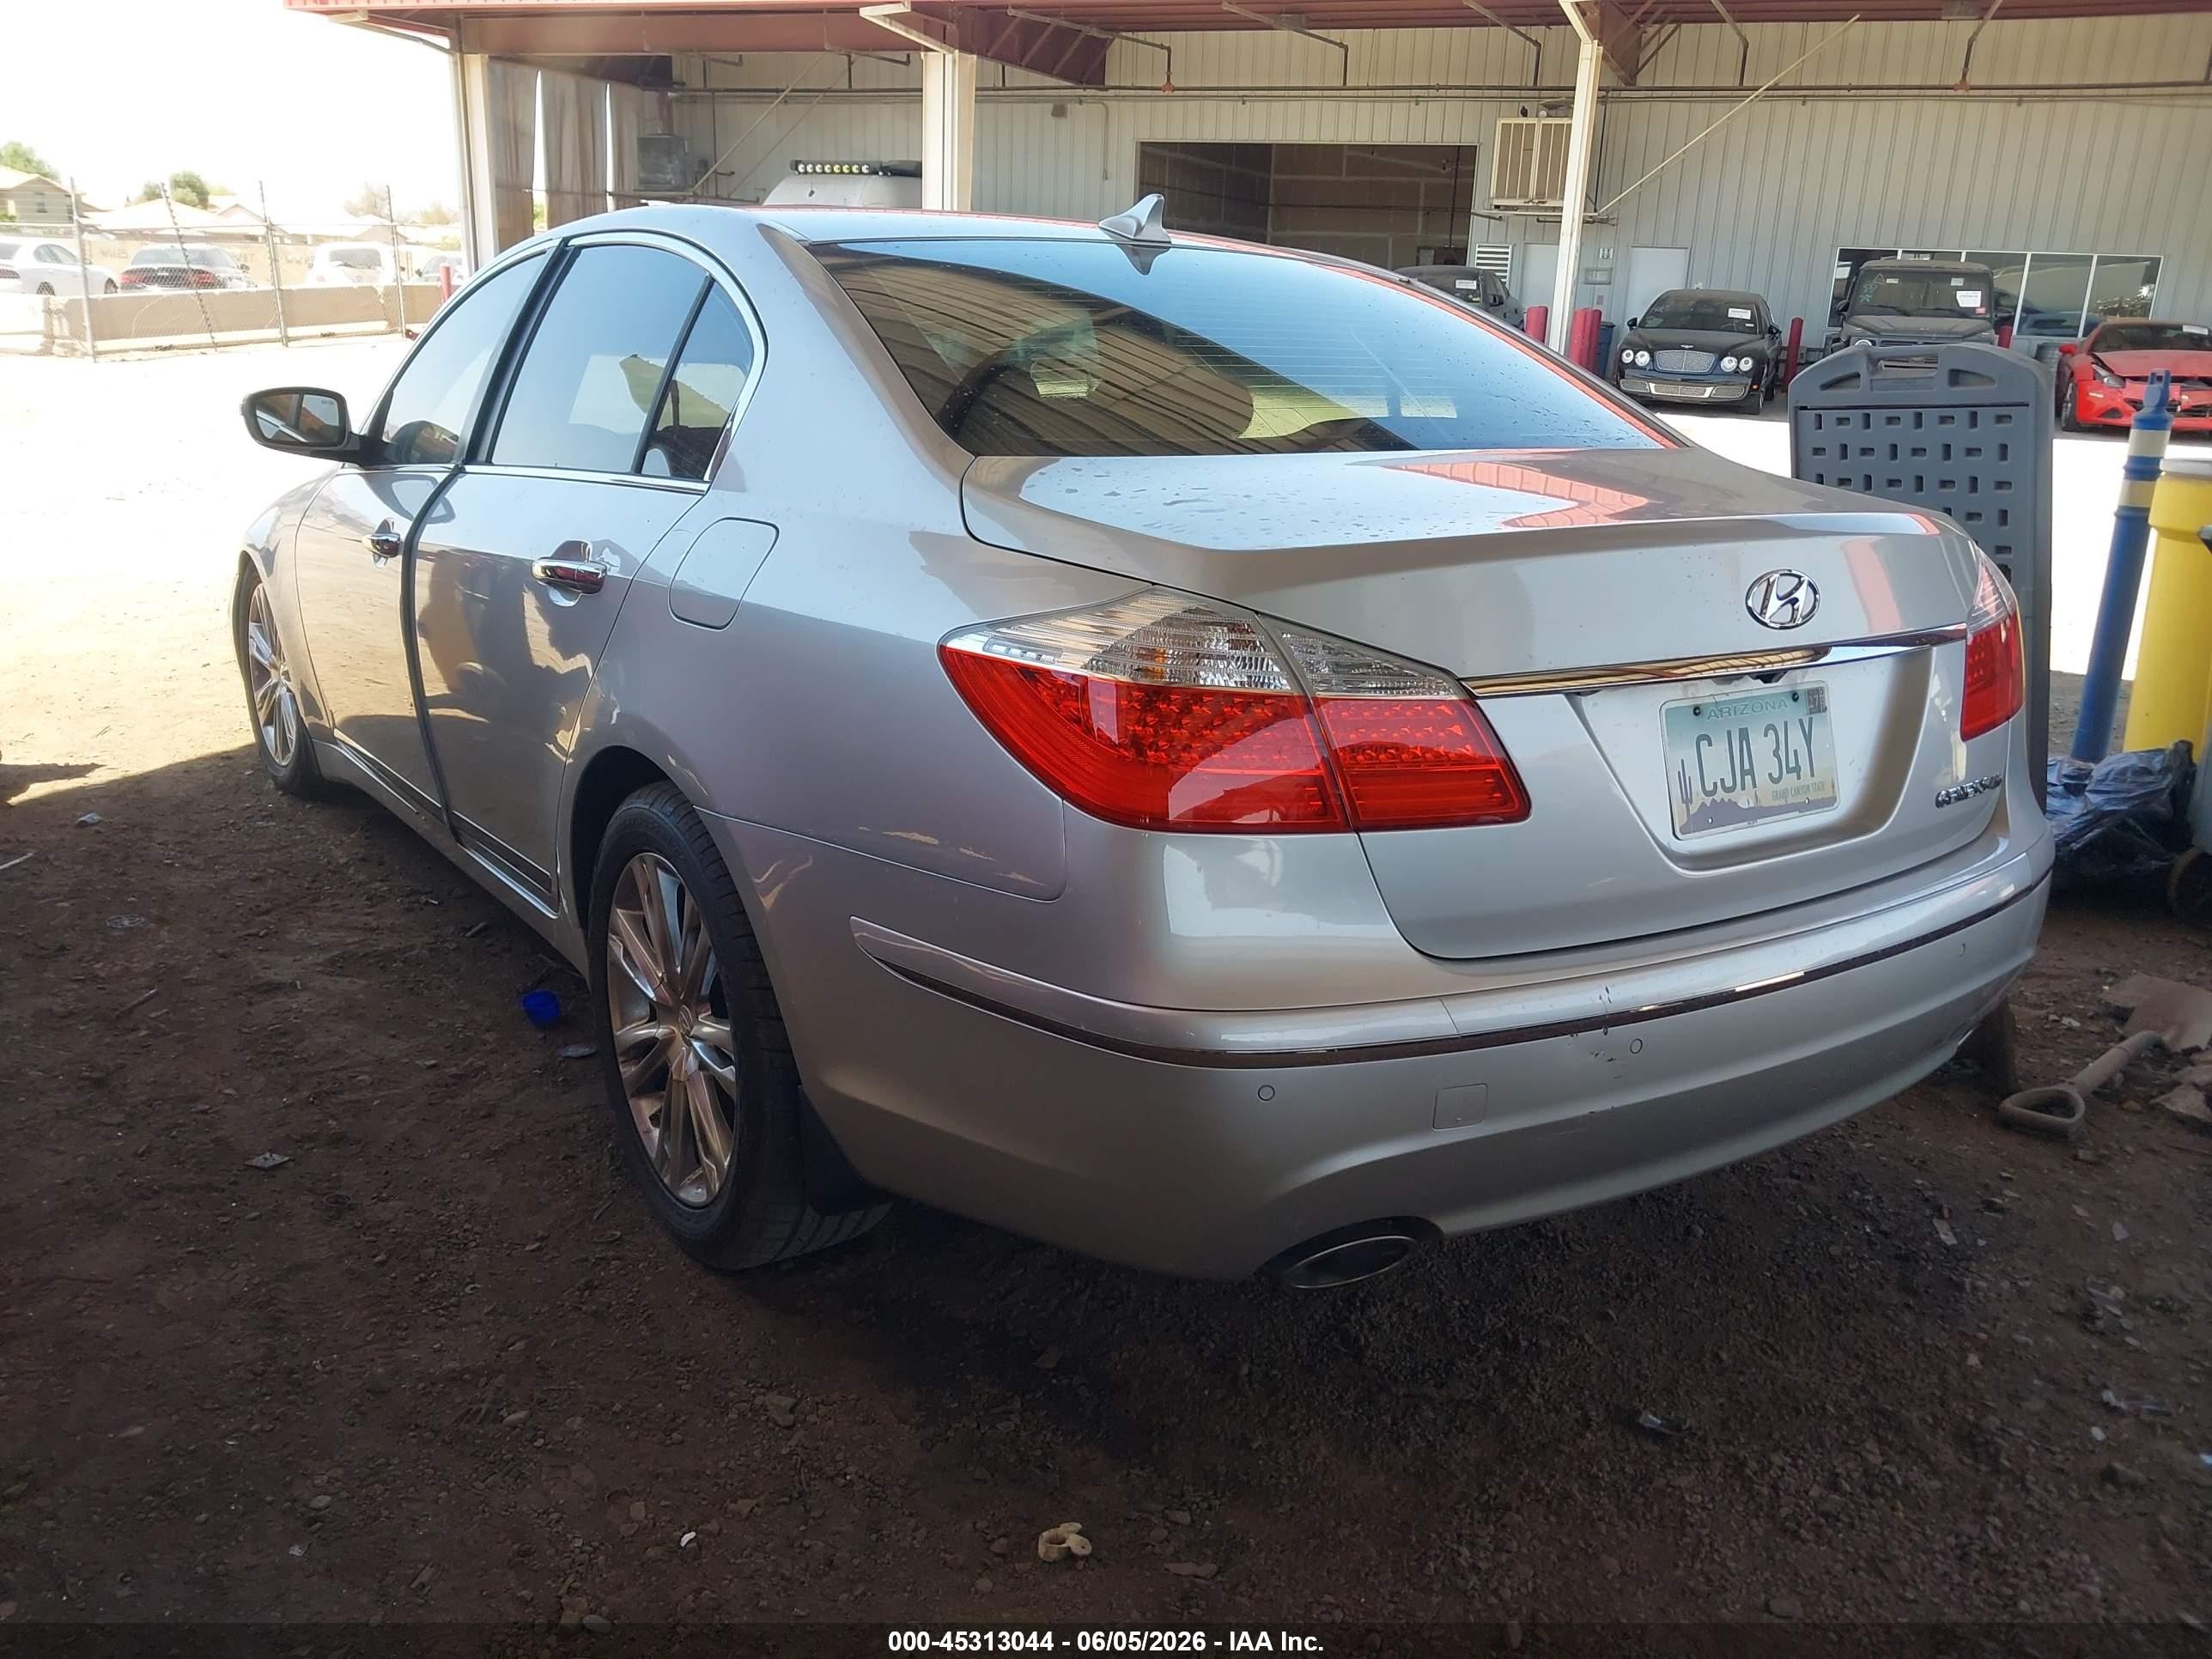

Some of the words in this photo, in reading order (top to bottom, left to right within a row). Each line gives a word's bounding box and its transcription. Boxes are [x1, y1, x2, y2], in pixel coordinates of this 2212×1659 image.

[1706, 698, 1789, 720] ARIZONA
[1695, 726, 1758, 798] CJA
[1763, 716, 1815, 786] 34Y
